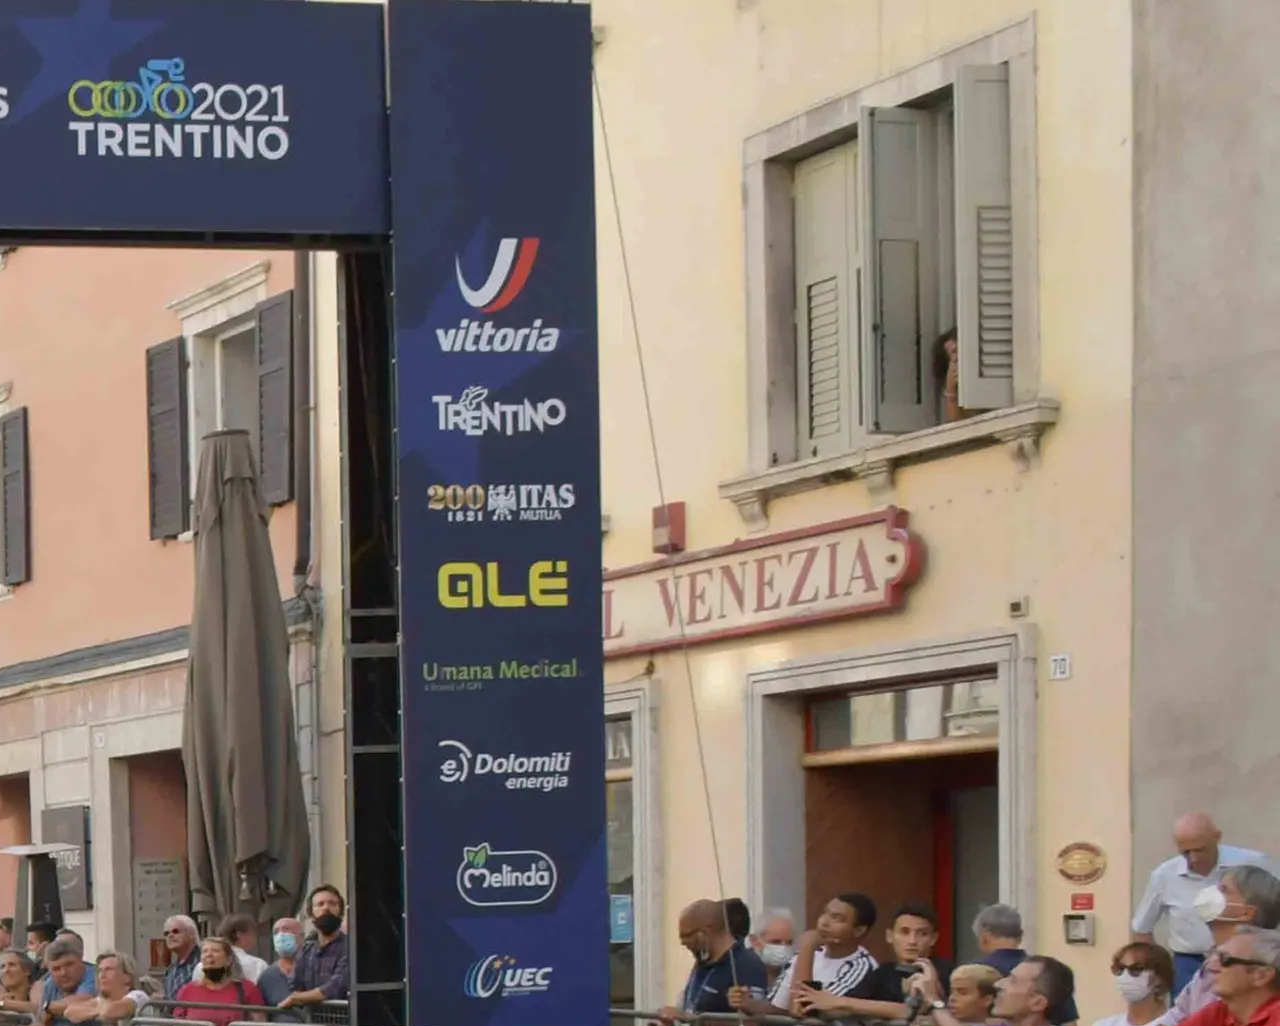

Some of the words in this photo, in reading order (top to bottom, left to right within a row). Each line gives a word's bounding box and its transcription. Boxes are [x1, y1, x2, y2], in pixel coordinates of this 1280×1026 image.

[188, 83, 289, 121] 2021
[69, 118, 289, 159] TRENTINO
[436, 319, 559, 352] vittoria
[427, 484, 485, 510] 200
[520, 484, 575, 508] ITAS
[447, 510, 483, 522] 1821
[520, 510, 561, 520] MUTUA
[656, 538, 880, 628] VENEZIA
[423, 662, 493, 681] Umana
[475, 752, 572, 775] Dolomiti
[505, 772, 568, 791] energia
[504, 967, 553, 987] UEC
